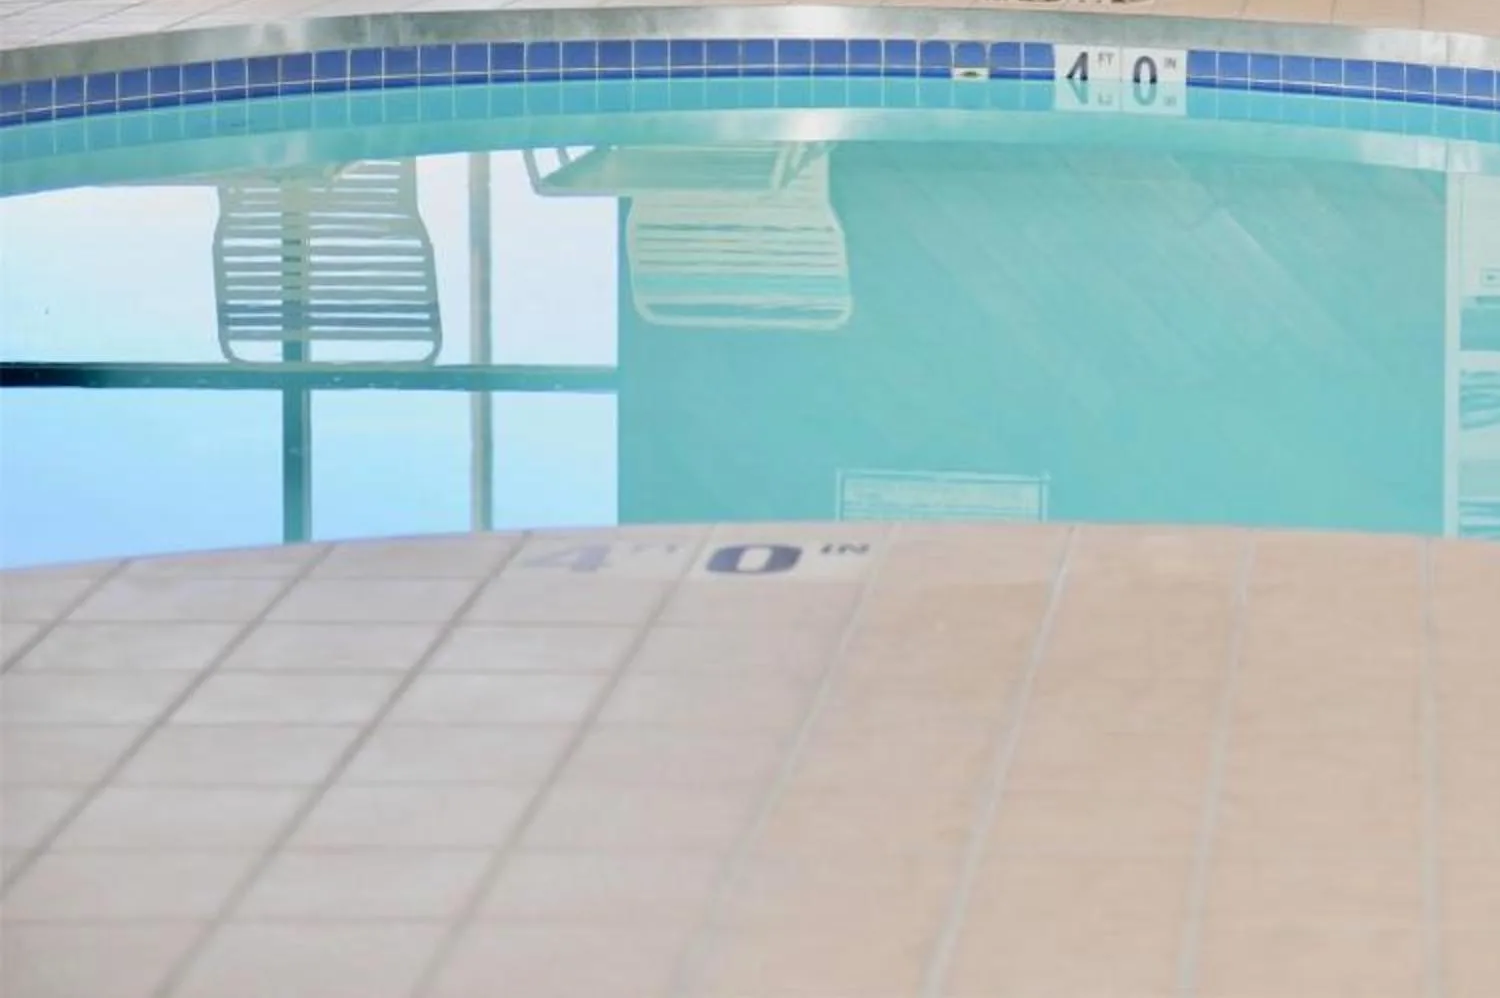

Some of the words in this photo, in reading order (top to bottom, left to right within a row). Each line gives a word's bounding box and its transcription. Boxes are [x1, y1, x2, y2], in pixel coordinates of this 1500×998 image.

[1066, 51, 1089, 81] 4
[1132, 55, 1158, 84] 0
[705, 543, 804, 574] 0
